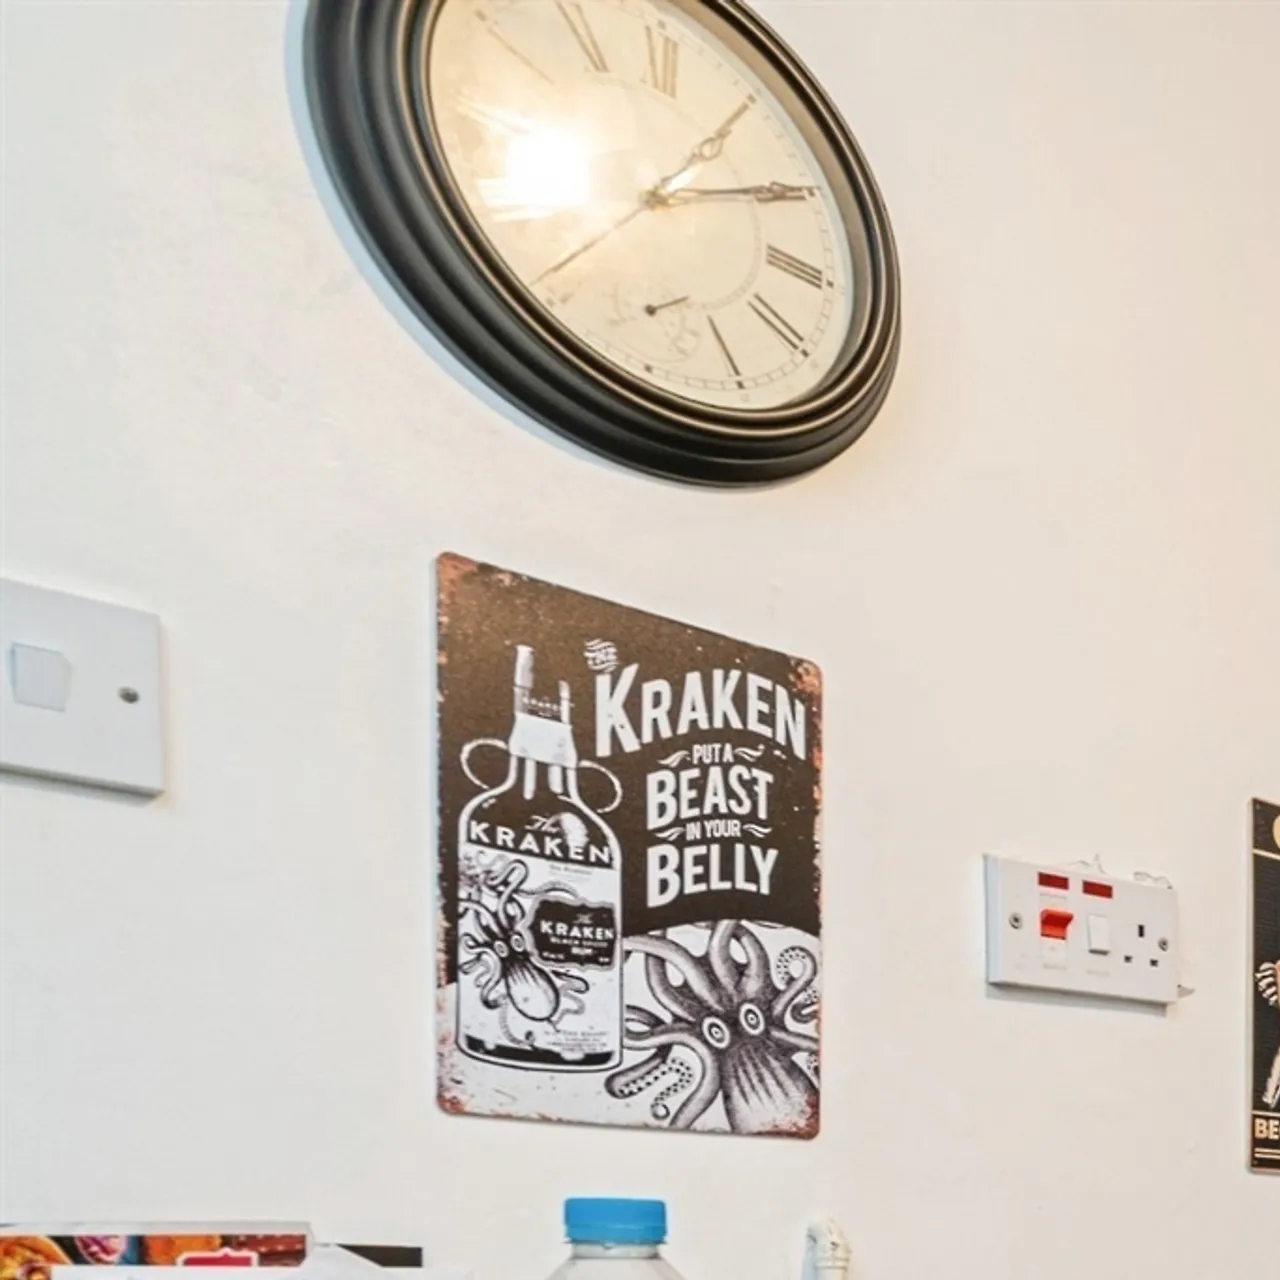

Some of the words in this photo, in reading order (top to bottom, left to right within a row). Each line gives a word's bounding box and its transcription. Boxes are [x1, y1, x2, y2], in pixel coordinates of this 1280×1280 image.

[595, 662, 807, 761] KRAKEN
[692, 746, 719, 764] PUT
[720, 743, 735, 762] A
[646, 766, 775, 830] BEAST
[469, 819, 612, 865] KRAKEN
[685, 822, 701, 840] IN
[702, 820, 742, 840] YOUR
[646, 842, 780, 908] BELLY
[540, 919, 614, 940] KRAKEN
